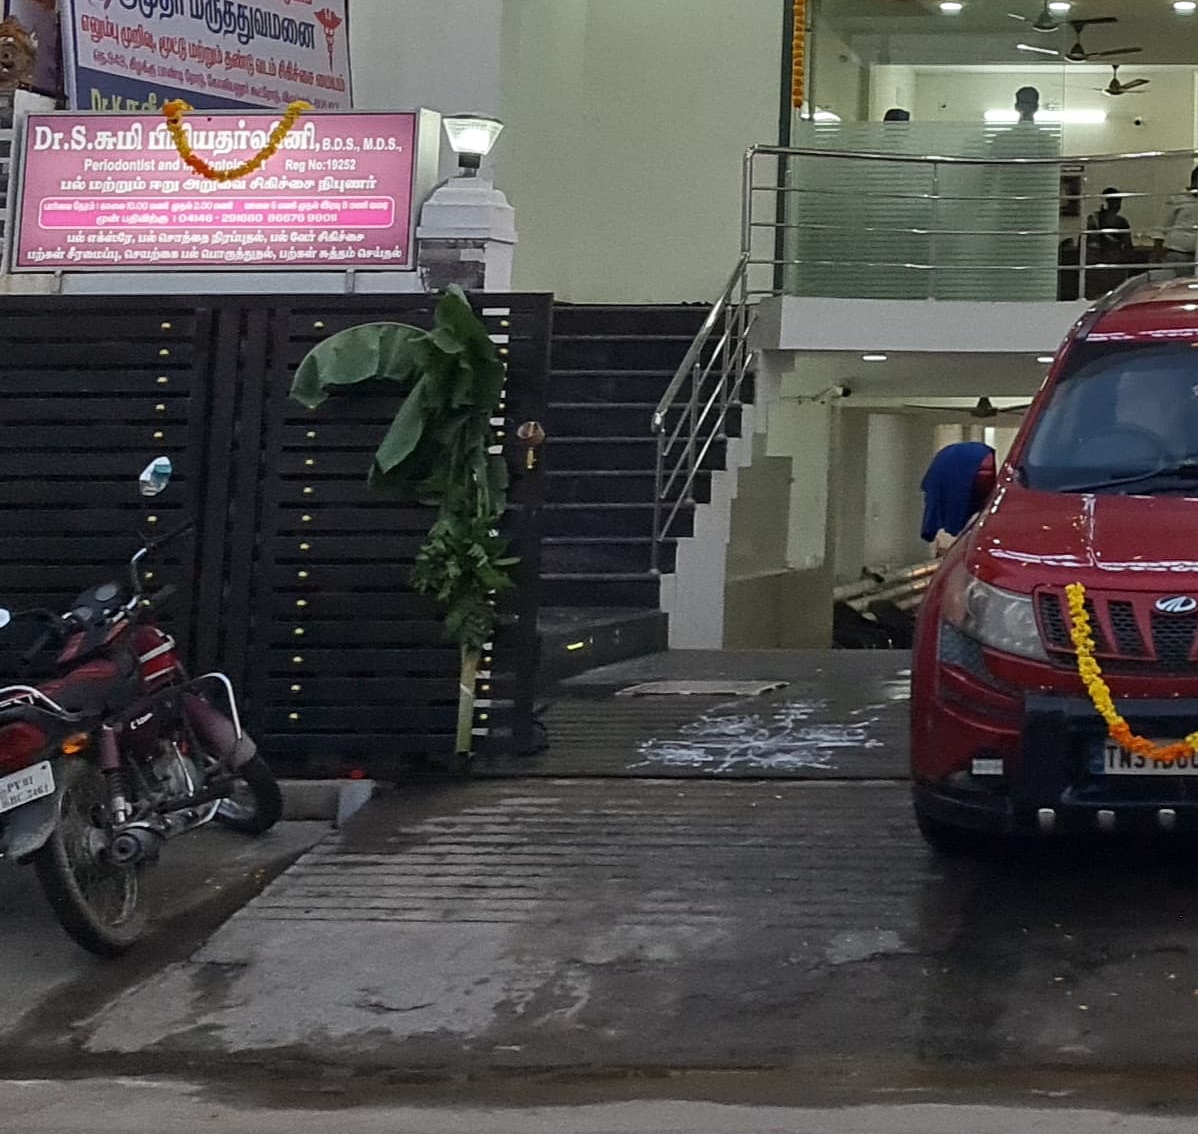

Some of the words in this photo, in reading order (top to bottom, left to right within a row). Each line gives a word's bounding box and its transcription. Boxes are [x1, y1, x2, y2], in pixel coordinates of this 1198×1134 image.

[34, 122, 143, 152] Dr.S.சுமி
[84, 159, 155, 172] Periodontist
[158, 159, 180, 172] and
[285, 159, 306, 173] Reg
[60, 176, 86, 191] பல்
[89, 176, 147, 194] மற்றும்
[182, 178, 247, 194] அறுவை
[249, 175, 315, 191] சிகிச்சை
[317, 175, 378, 193] நிபுணர்
[67, 230, 85, 244] பல்
[137, 230, 156, 244] பல்
[269, 229, 289, 243] பல்
[180, 245, 200, 260] பல்
